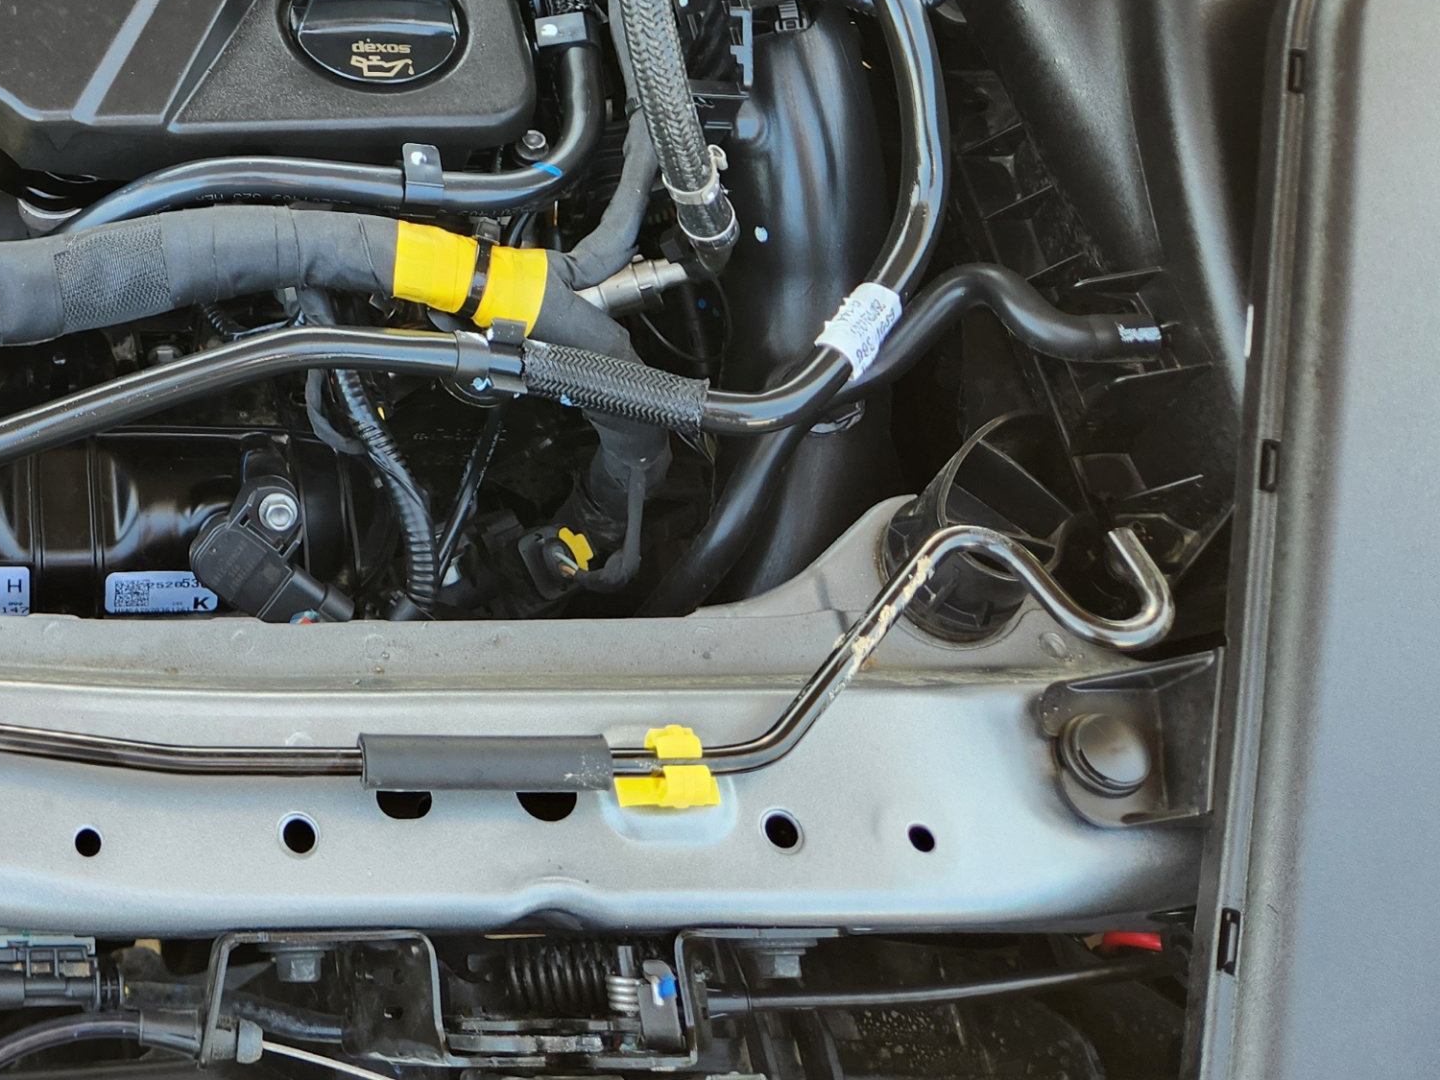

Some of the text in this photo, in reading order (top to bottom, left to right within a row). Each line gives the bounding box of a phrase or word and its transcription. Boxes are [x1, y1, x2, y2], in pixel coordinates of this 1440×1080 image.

[351, 40, 412, 54] dexos
[7, 578, 22, 593] H
[192, 596, 211, 610] K
